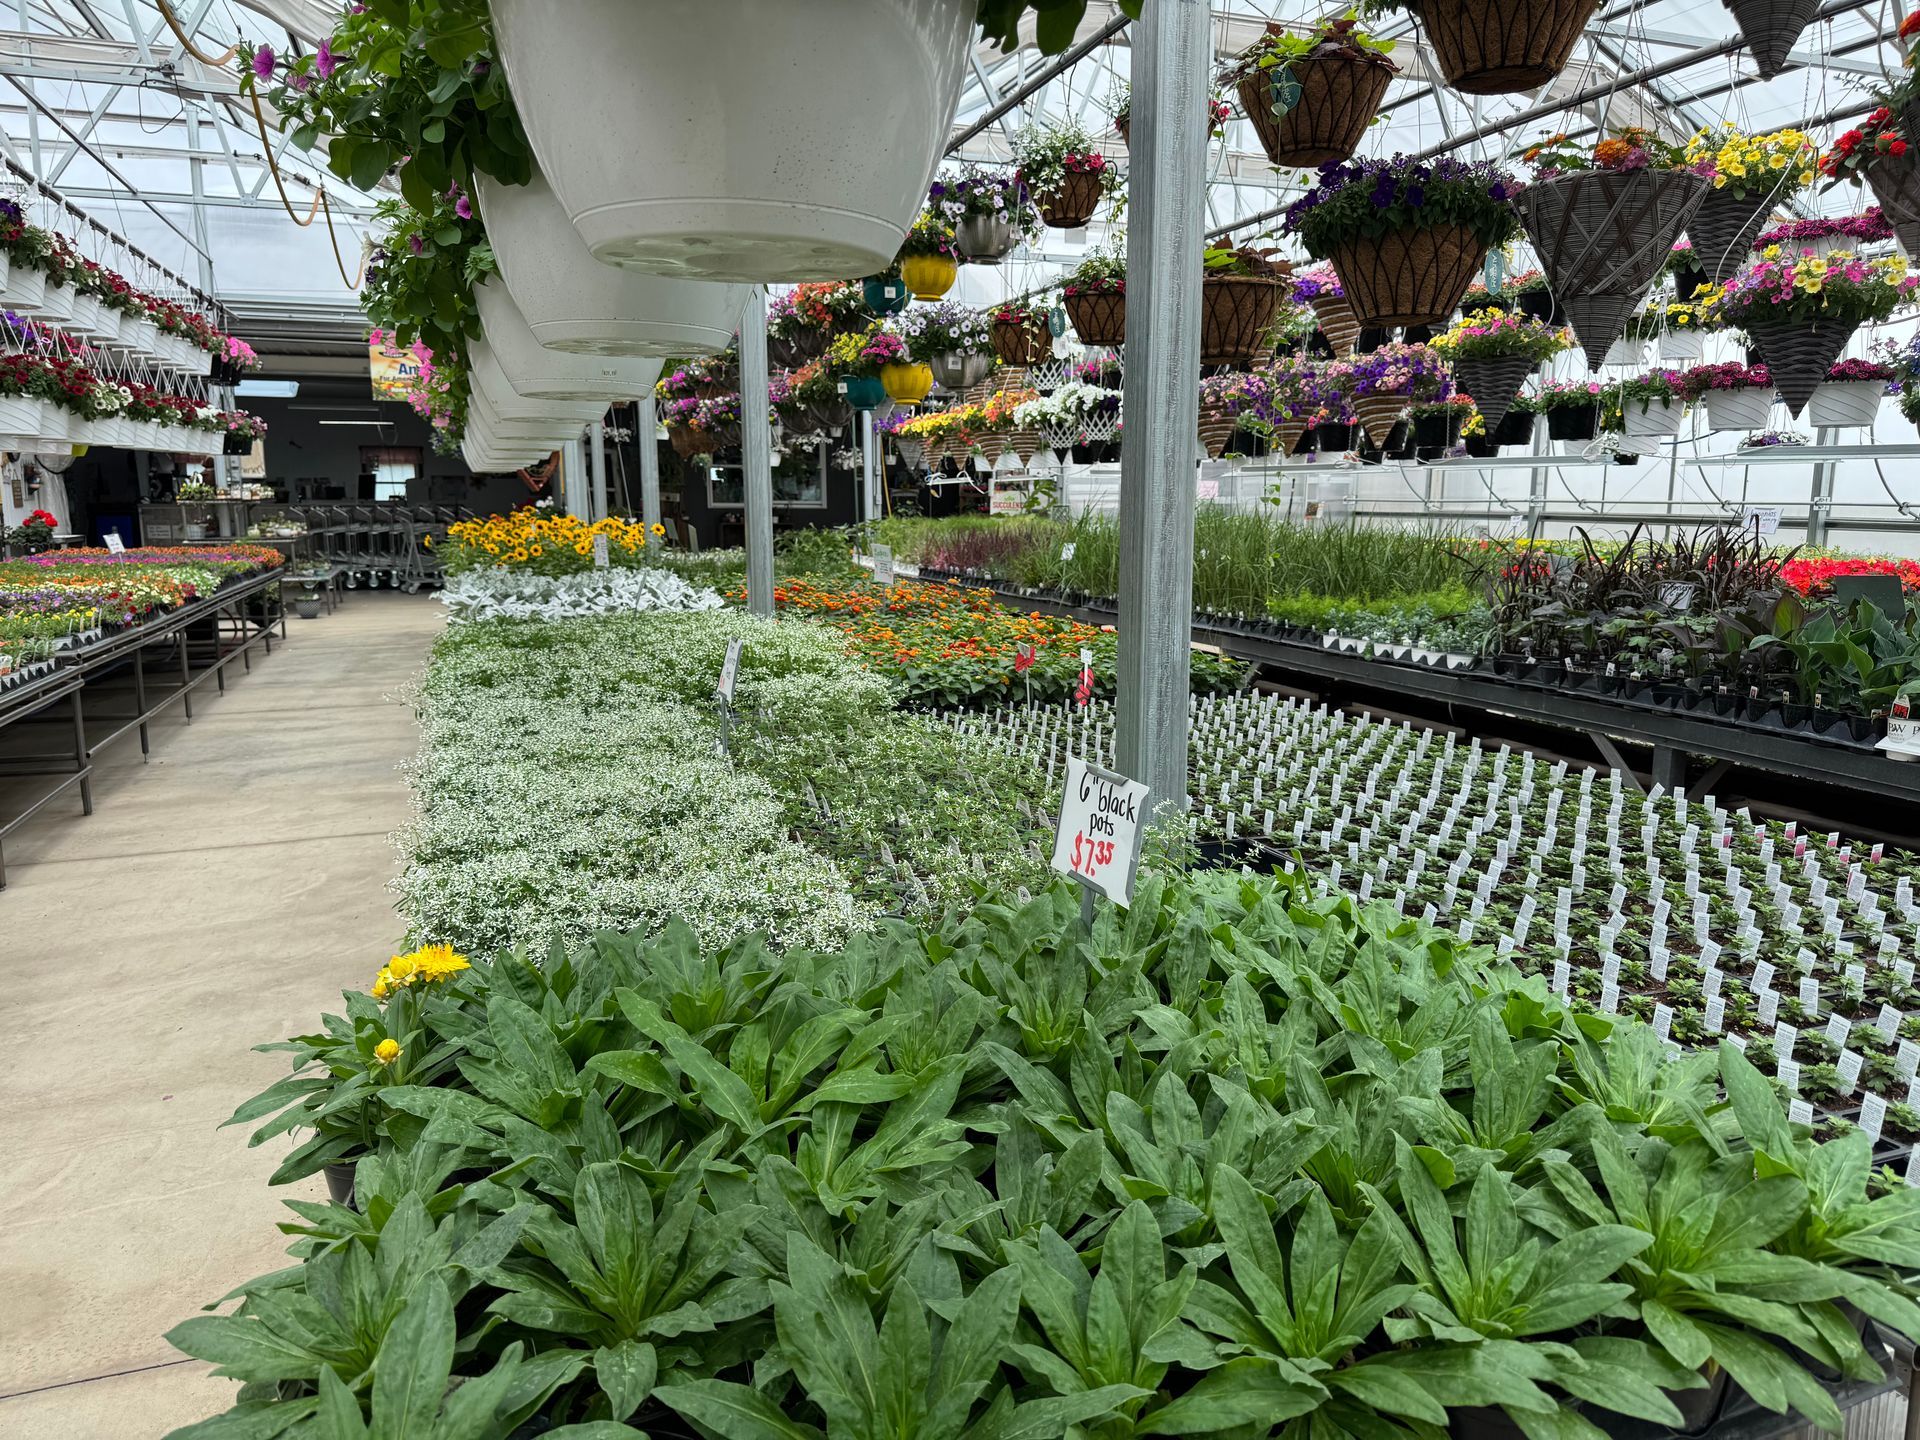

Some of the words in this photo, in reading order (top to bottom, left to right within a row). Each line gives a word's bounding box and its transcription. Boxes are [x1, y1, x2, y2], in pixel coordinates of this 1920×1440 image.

[399, 363, 417, 375] An
[1079, 771, 1099, 802] 6"
[1098, 781, 1136, 823] black
[1089, 813, 1115, 837] pots
[1070, 830, 1115, 877] $7.35
